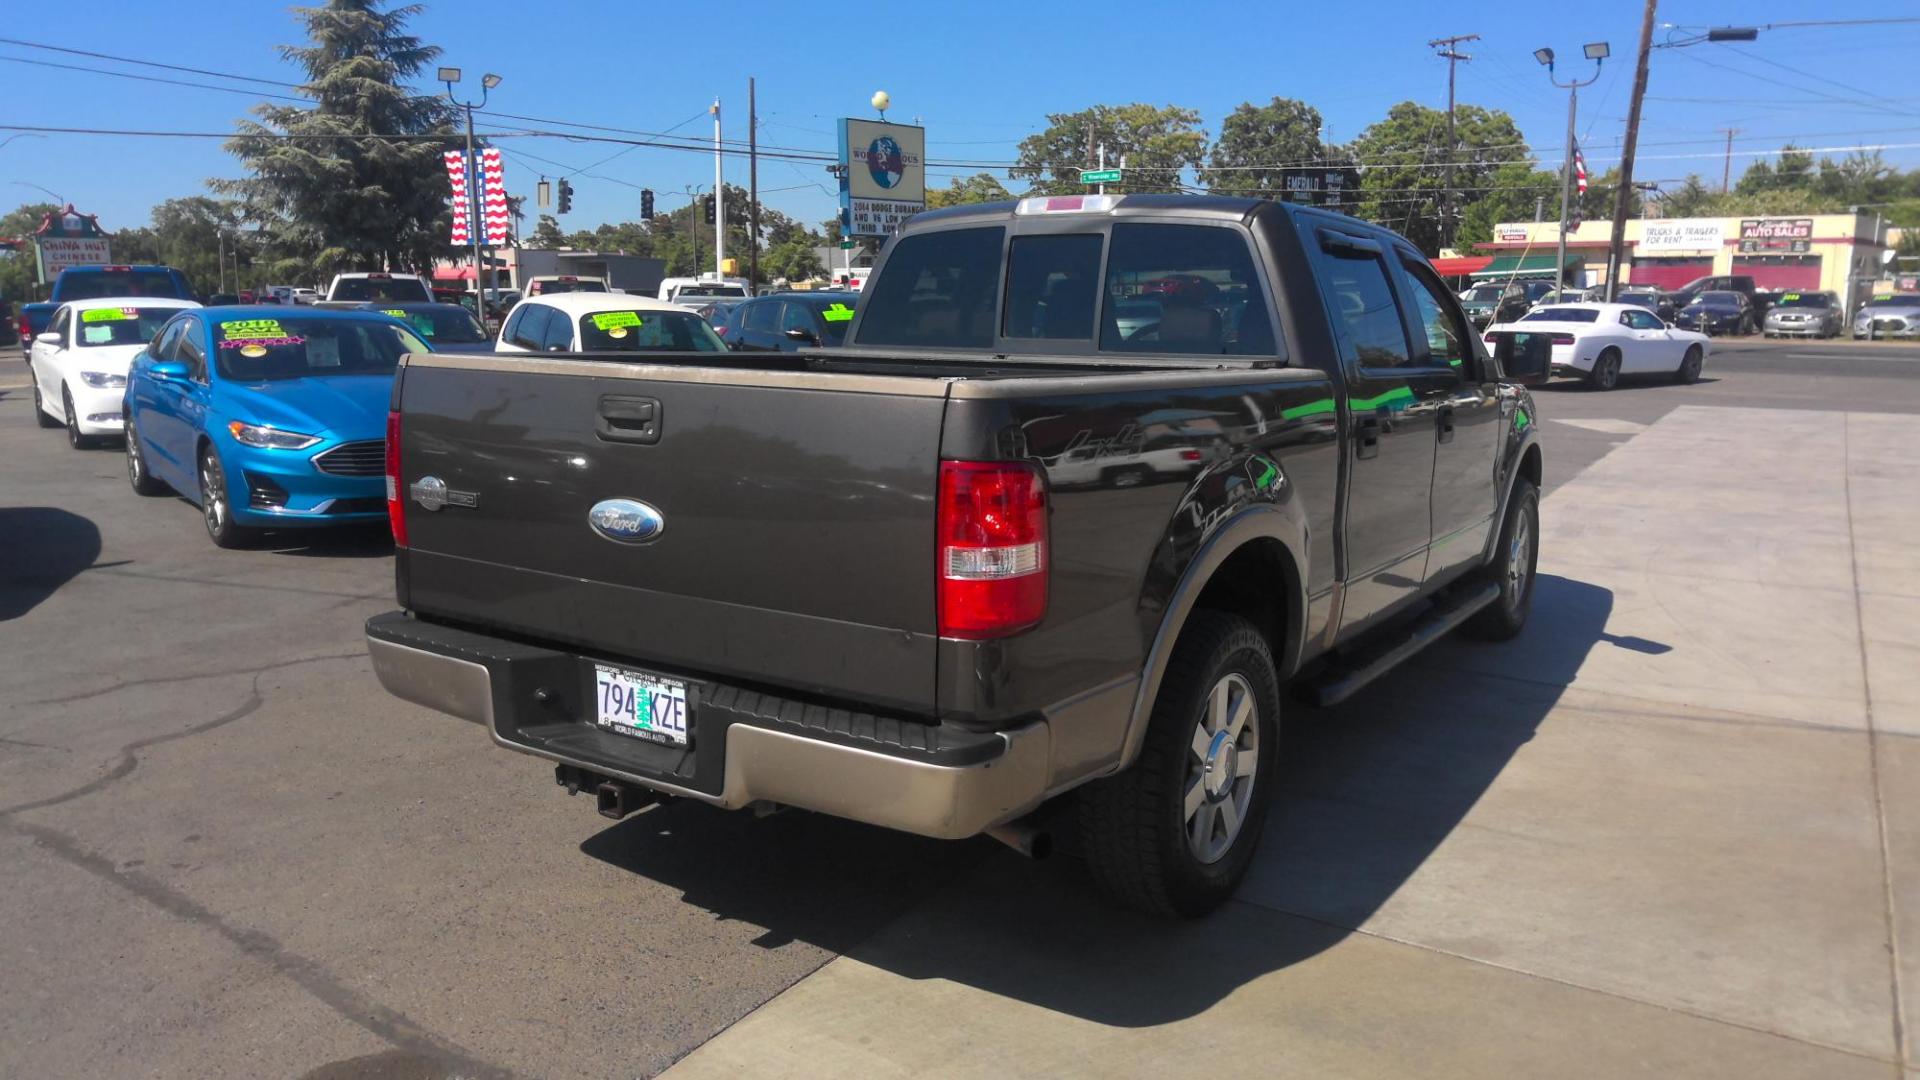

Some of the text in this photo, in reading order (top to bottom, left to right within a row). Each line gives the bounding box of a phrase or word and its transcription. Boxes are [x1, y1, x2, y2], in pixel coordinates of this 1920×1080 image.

[1287, 176, 1319, 191] EMERALD
[871, 203, 892, 213] DODGE
[857, 223, 877, 233] THIRD
[1646, 227, 1673, 235] TRUCKS
[1744, 226, 1808, 237] AUTO SALES
[1646, 236, 1661, 244] FOR
[1663, 235, 1683, 244] RENT
[44, 240, 106, 250] CHINA HUT
[52, 252, 101, 261] CHINESE
[598, 508, 641, 533] Ford
[594, 664, 620, 675] MEDFORD
[660, 677, 684, 688] OREGON
[599, 680, 686, 732] 794 KZE
[614, 724, 631, 735] WORLD
[652, 733, 666, 743] AUTO
